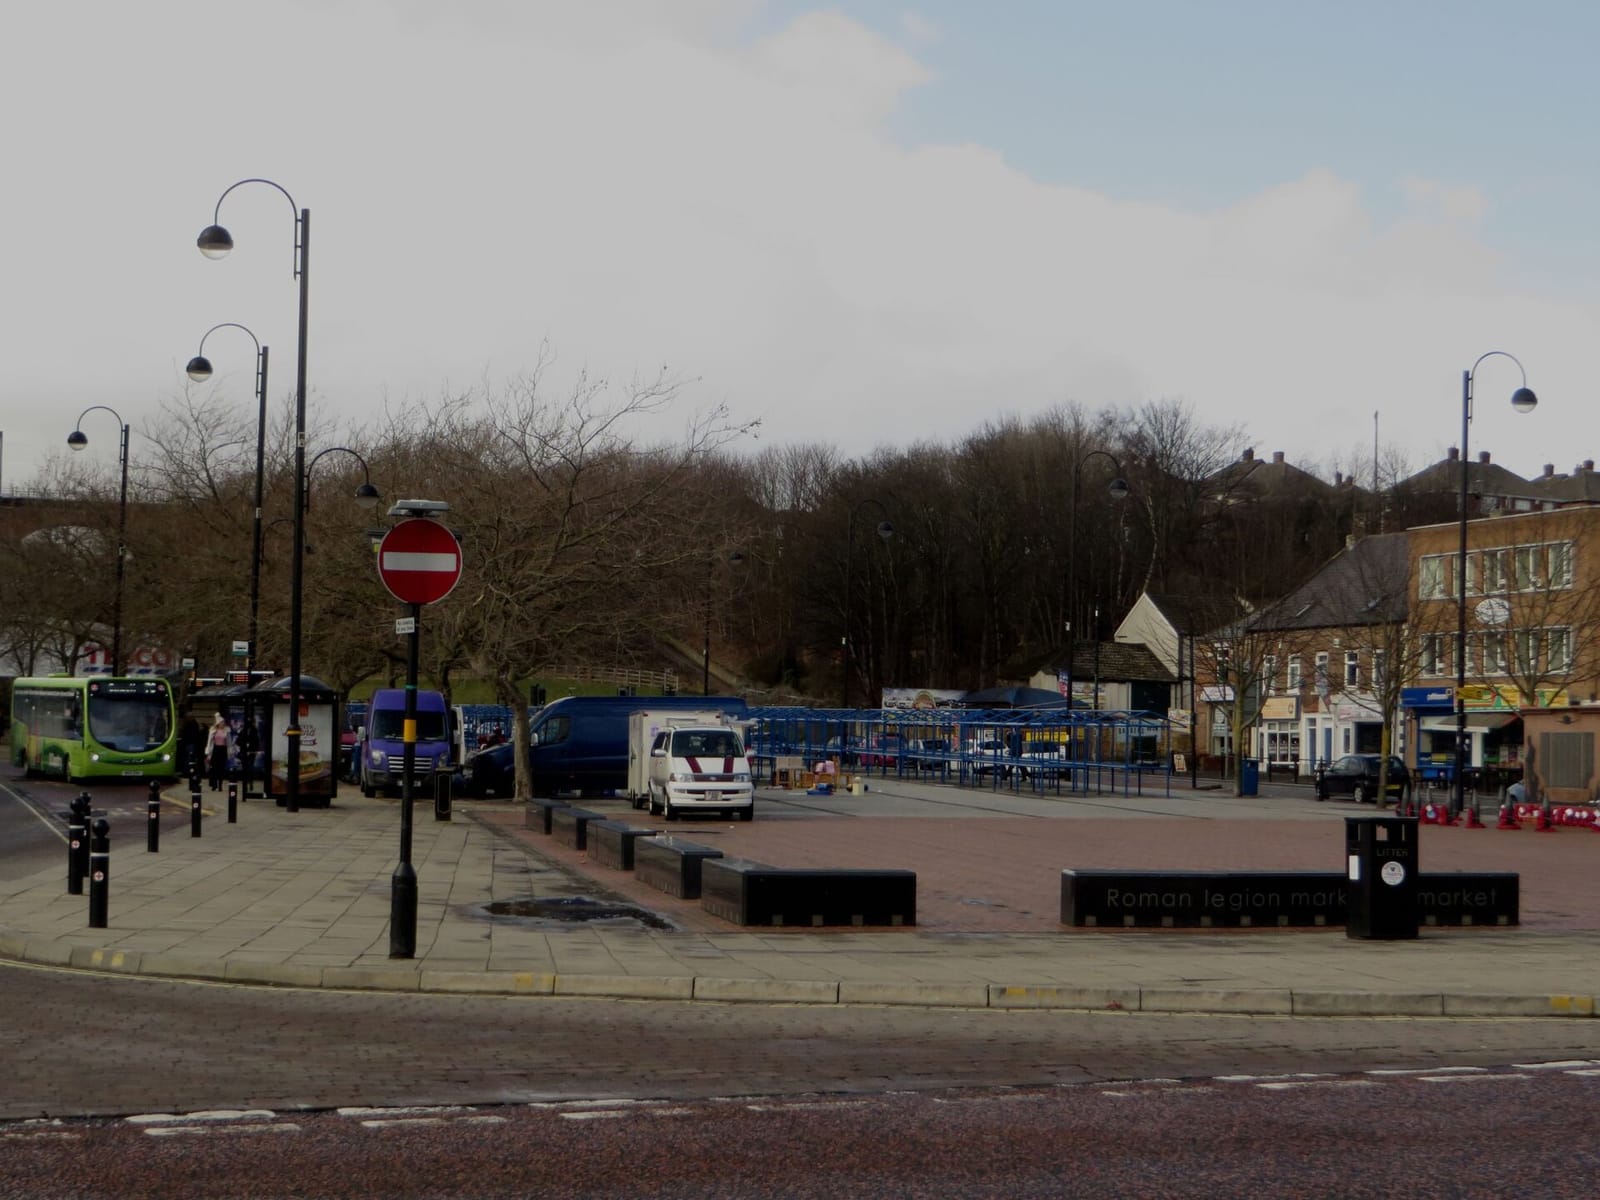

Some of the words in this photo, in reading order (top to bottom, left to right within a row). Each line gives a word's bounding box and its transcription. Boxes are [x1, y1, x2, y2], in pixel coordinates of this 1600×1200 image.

[83, 646, 170, 666] TCO
[1376, 848, 1408, 857] LITTER
[1106, 888, 1192, 908] Roman
[1204, 888, 1281, 911] legion
[1290, 887, 1347, 906] mark
[1416, 887, 1496, 907] market
